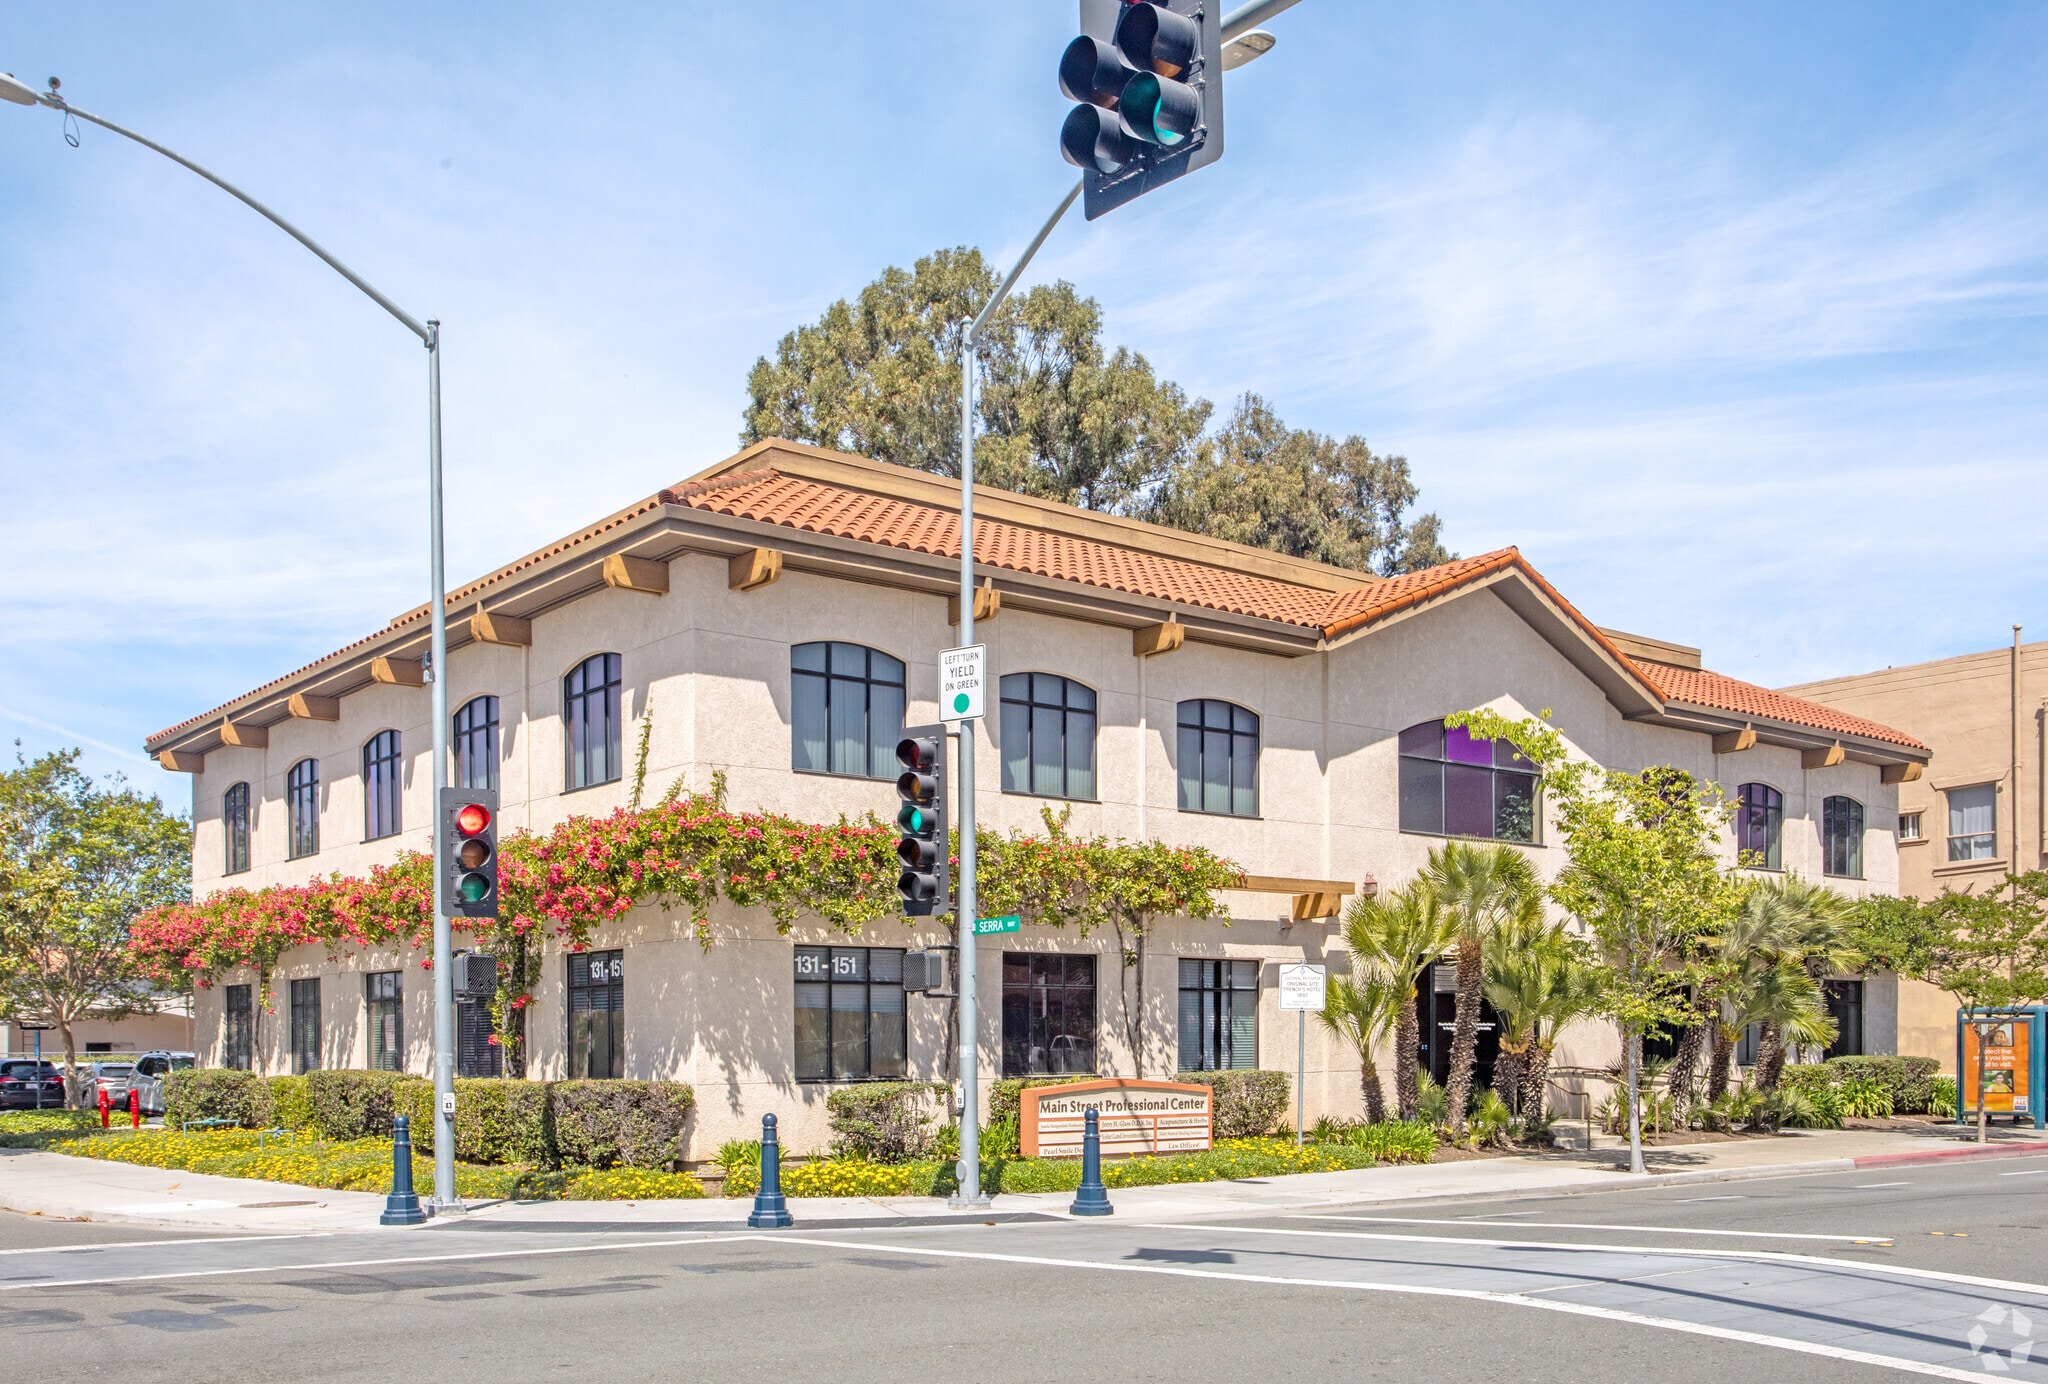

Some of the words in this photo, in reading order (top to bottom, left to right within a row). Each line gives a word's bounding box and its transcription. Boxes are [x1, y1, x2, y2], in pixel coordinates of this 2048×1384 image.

[945, 655, 960, 665] LEFT
[961, 652, 979, 662] TURN
[950, 665, 975, 678] YIELD
[945, 682, 954, 691] ON
[957, 679, 979, 690] GREEN
[979, 920, 1004, 932] SERRA
[1040, 1100, 1068, 1113] Main
[1106, 1098, 1168, 1112] Professional
[1171, 1098, 1204, 1110] Center
[1159, 1118, 1188, 1126] Acupuncture
[1043, 1147, 1058, 1155] Pearl
